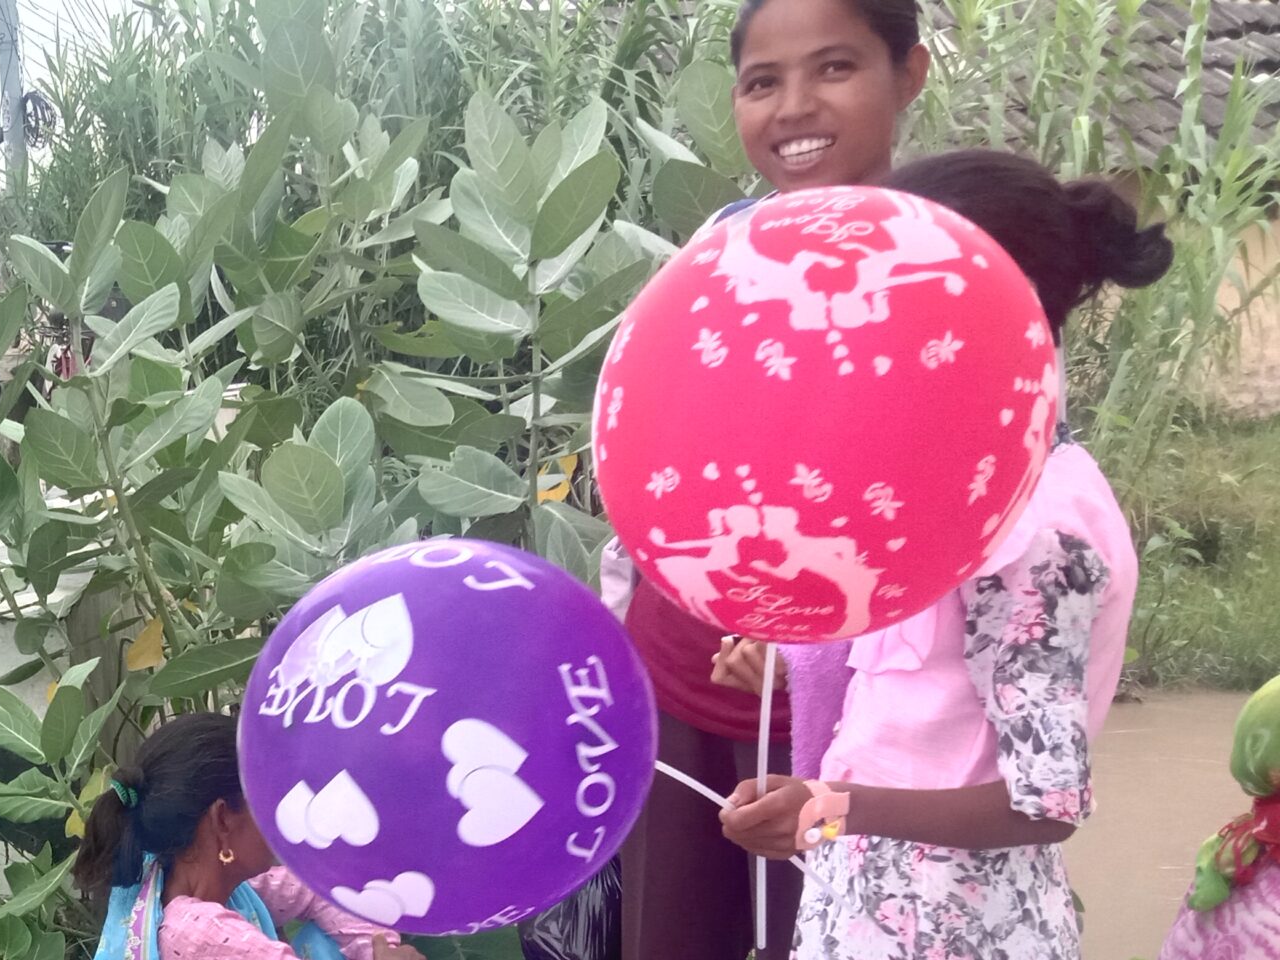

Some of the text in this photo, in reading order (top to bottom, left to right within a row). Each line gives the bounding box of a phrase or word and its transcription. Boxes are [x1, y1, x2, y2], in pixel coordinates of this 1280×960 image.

[760, 212, 844, 235] Love
[753, 594, 835, 615] Love
[258, 670, 438, 736] LOVE
[558, 655, 620, 863] LOVE
